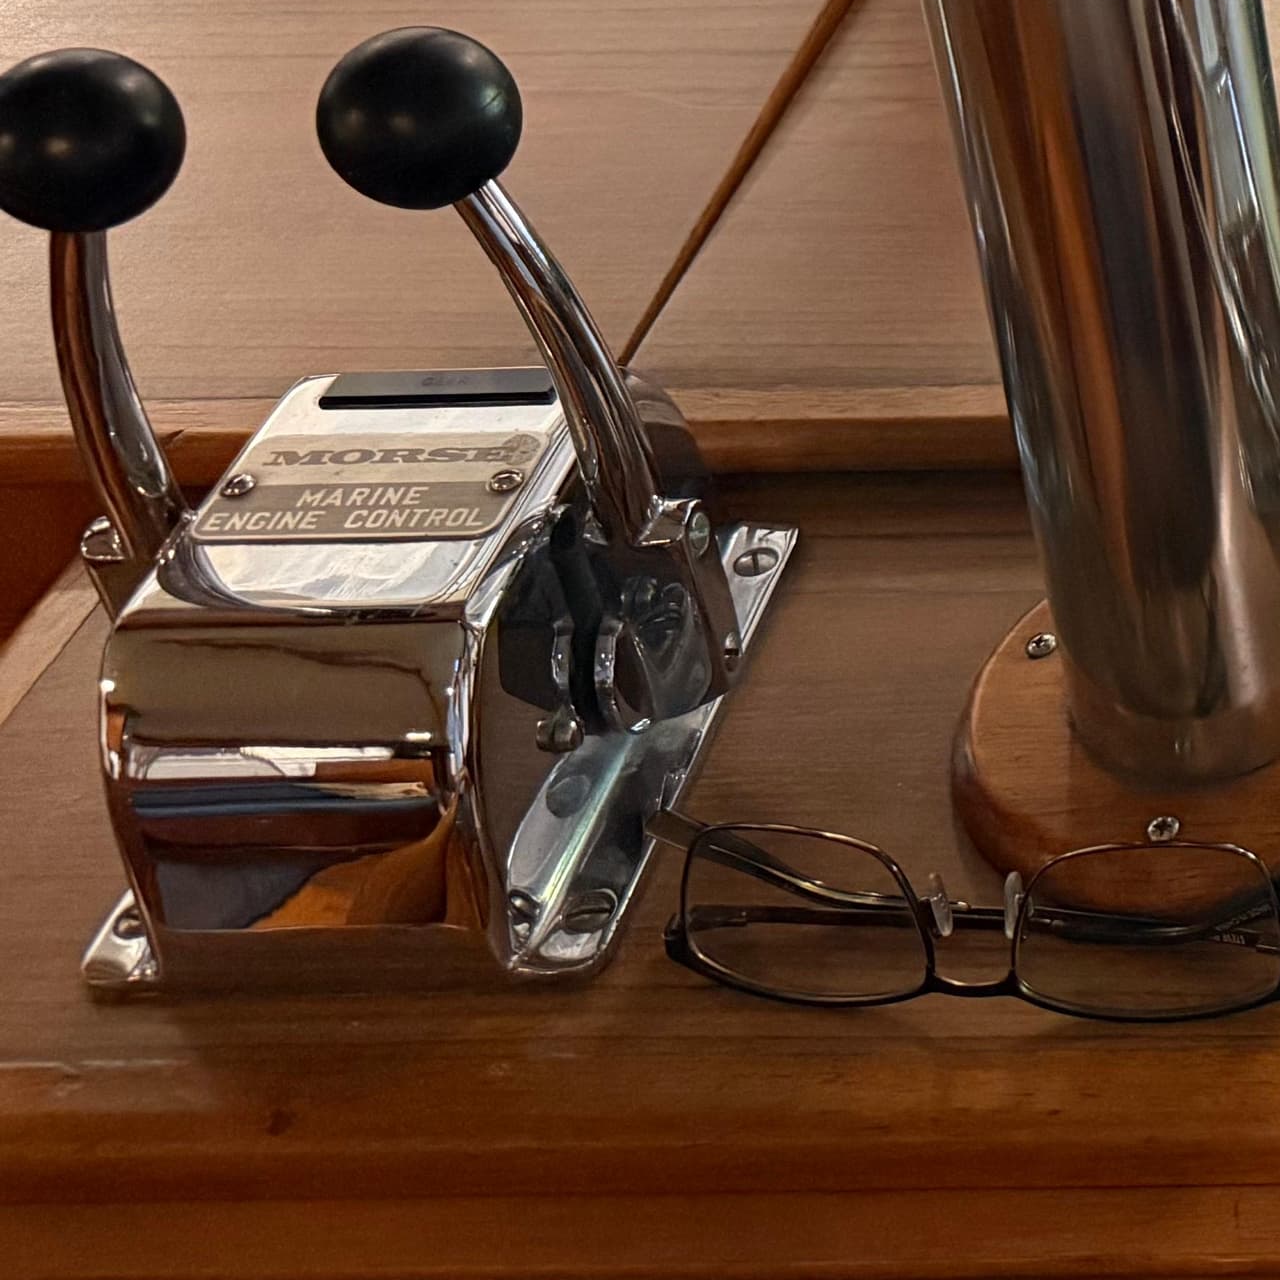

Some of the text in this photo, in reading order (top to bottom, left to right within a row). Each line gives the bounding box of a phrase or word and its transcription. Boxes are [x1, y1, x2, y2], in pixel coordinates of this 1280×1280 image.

[261, 445, 512, 467] MORSE
[296, 485, 430, 508] MARINE
[202, 506, 485, 531] ENGINE CONTROL
